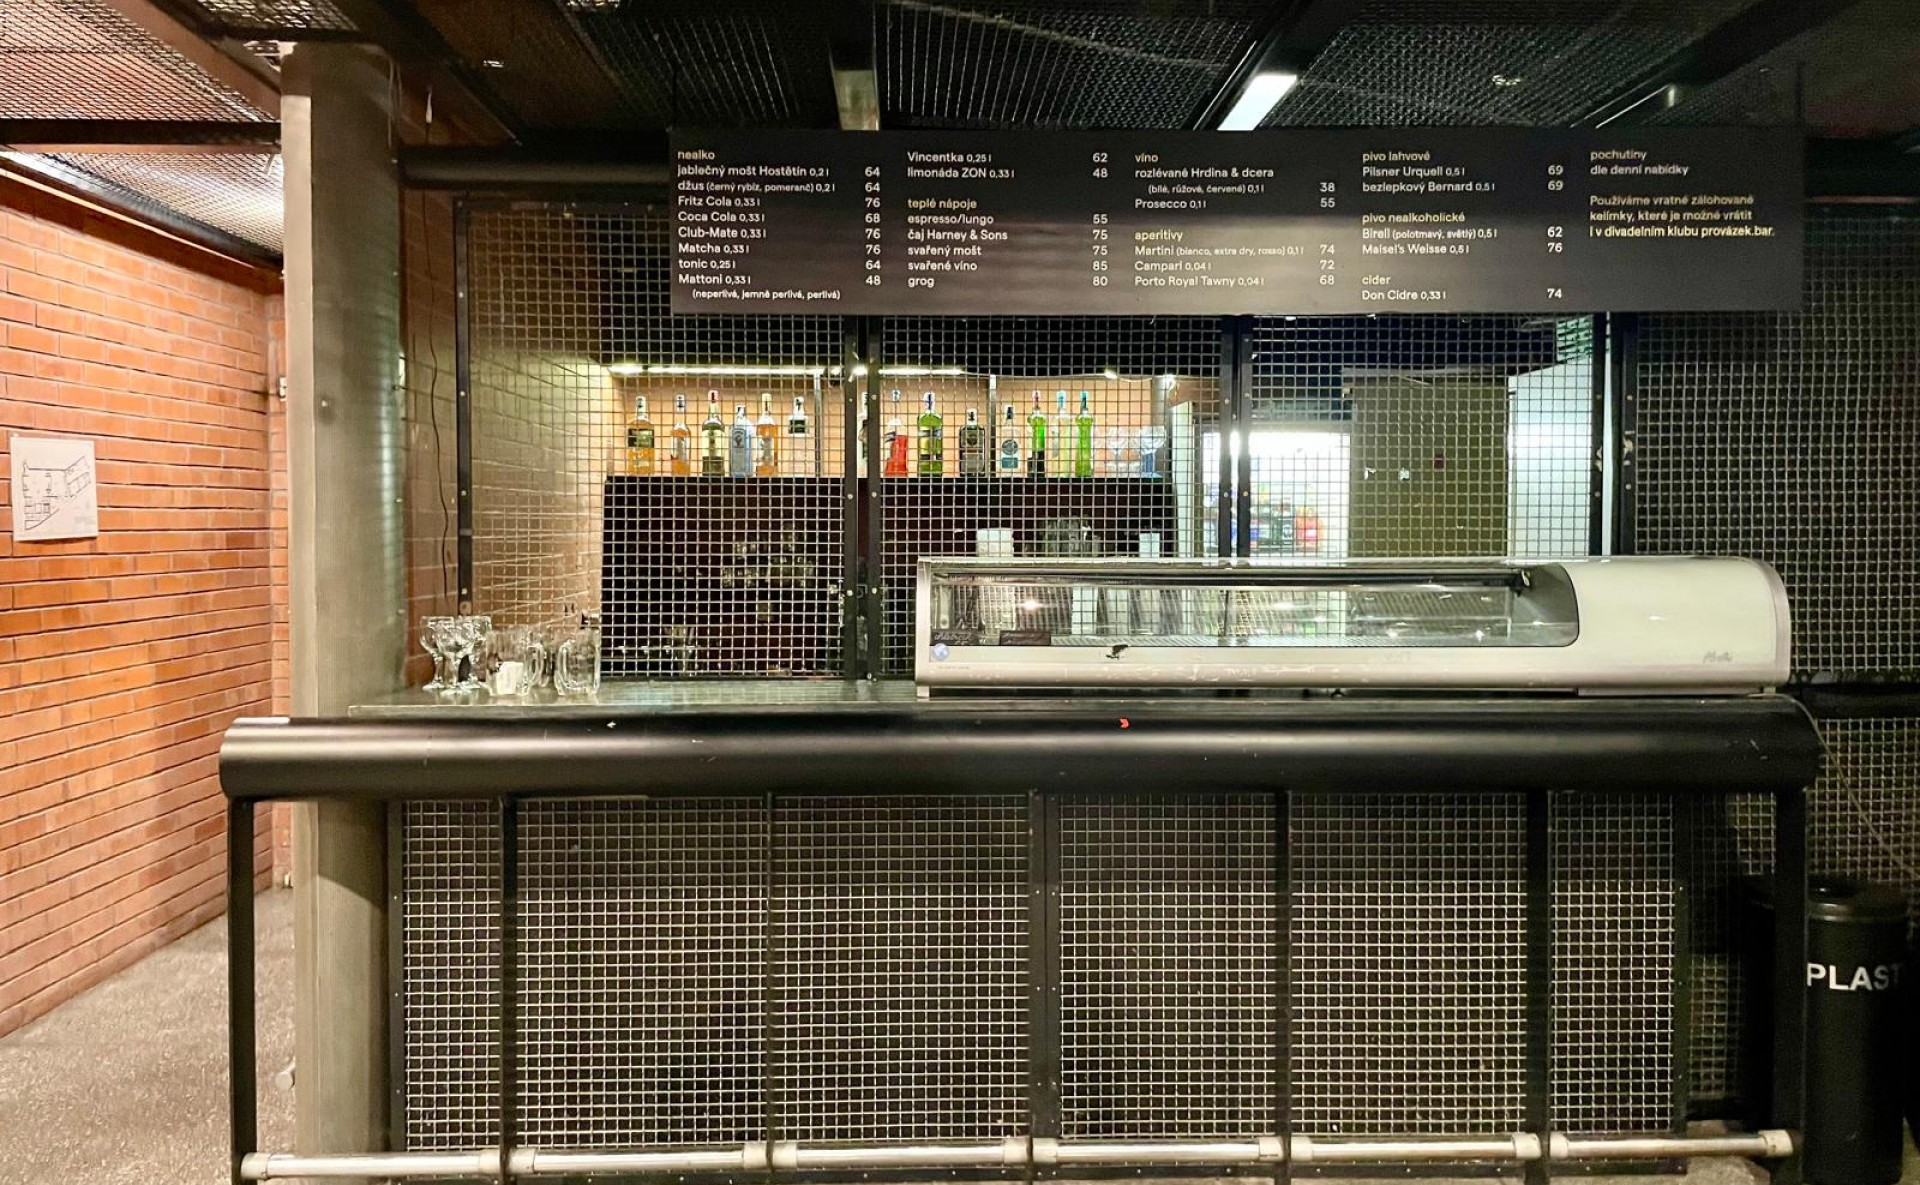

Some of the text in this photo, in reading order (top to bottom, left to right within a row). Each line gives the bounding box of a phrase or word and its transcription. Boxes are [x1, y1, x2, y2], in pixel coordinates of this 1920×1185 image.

[677, 150, 716, 159] nealko
[907, 152, 965, 162] Vincentka
[1092, 153, 1109, 162] 62
[1134, 154, 1159, 162] víno
[1362, 151, 1430, 163] pivo lahvové
[1590, 150, 1648, 161] pochutiny
[677, 165, 726, 177] jablečný
[727, 166, 757, 175] mošt
[864, 167, 881, 177] 64
[907, 167, 960, 177] limonáda
[961, 168, 987, 177] ZON
[1092, 168, 1109, 177] 48
[1134, 168, 1274, 177] rozlévané Hrdina & dcera
[1362, 167, 1400, 176] Pilsner
[1402, 166, 1443, 178] Urquell
[1547, 165, 1564, 175] 69
[1590, 165, 1689, 175] dle denní nabídky
[677, 181, 704, 190] džus
[864, 183, 881, 192] 64
[1319, 183, 1335, 192] 38
[1362, 182, 1425, 194] bezlepkový
[1427, 182, 1473, 191] Bernard
[1547, 181, 1564, 190] 69
[678, 196, 703, 206] Fritz
[706, 196, 732, 206] Cola
[864, 198, 881, 207] 76
[907, 199, 977, 210] teplé nápoje
[1134, 199, 1188, 208] Prosecco
[1319, 198, 1335, 207] 55
[1589, 196, 1651, 205] Používáme
[678, 211, 708, 221] Coca
[710, 212, 737, 221] Cola
[864, 213, 881, 223] 68
[907, 214, 994, 226] espresso/lungo
[1092, 214, 1109, 224] 55
[1361, 212, 1465, 225] pivo nealkoholické
[1637, 211, 1668, 220] které
[1669, 211, 1681, 222] je
[678, 227, 738, 237] Club-Mate
[864, 228, 881, 239] 76
[907, 229, 1008, 242] čaj Harney & Sons
[1092, 230, 1109, 240] 75
[1134, 229, 1183, 242] aperitivy
[1361, 228, 1390, 238] Birell
[1547, 227, 1563, 237] 62
[1604, 226, 1665, 237] divadelním
[1667, 226, 1699, 236] klubu
[678, 243, 721, 253] Matcha
[865, 245, 881, 254] 76
[907, 245, 982, 257] svařený mošt
[1092, 245, 1109, 255] 75
[1134, 245, 1175, 255] Martini
[1258, 246, 1285, 256] rosso)
[1319, 244, 1335, 254] 74
[1361, 244, 1405, 254] Maisel's
[1407, 244, 1447, 254] Weisse
[1547, 243, 1563, 252] 76
[678, 259, 708, 268] tonic
[865, 260, 881, 269] 64
[907, 261, 978, 271] svařené víno
[1092, 261, 1109, 270] 85
[1134, 261, 1183, 272] Campari
[1319, 260, 1335, 269] 72
[678, 274, 723, 284] Mattoni
[865, 275, 881, 285] 48
[907, 278, 935, 288] grog
[1092, 276, 1109, 286] 80
[1134, 276, 1166, 286] Porto
[1168, 276, 1199, 287] Royal
[1200, 276, 1236, 287] Tawny
[1319, 275, 1335, 285] 68
[1361, 275, 1391, 284] cider
[1361, 290, 1385, 300] Don
[1387, 290, 1418, 299] Cidre
[1546, 288, 1563, 298] 74
